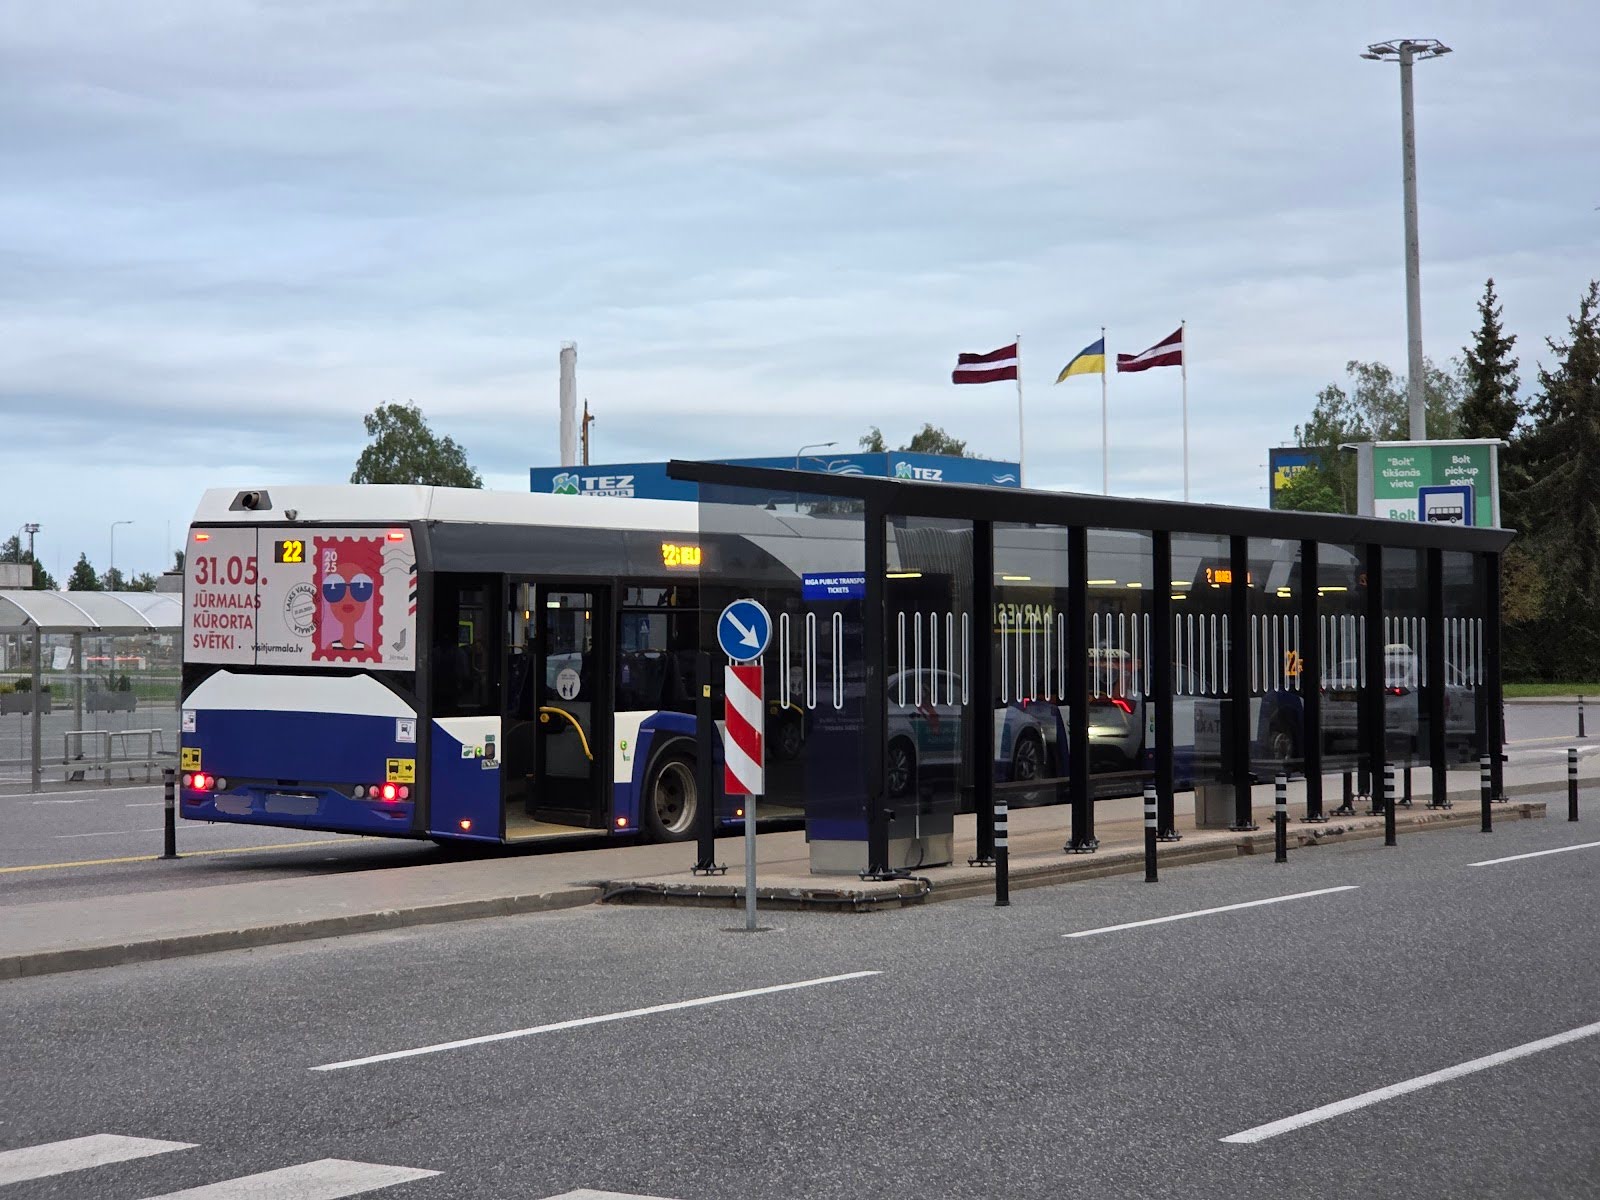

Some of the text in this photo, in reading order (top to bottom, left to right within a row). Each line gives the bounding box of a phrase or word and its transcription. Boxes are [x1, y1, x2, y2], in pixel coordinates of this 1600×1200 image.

[1452, 455, 1471, 464] Bolt
[912, 467, 943, 482] TEZ
[1382, 468, 1421, 478] tikšanās
[1444, 466, 1479, 477] pick-up
[581, 475, 635, 490] TEZ
[1389, 479, 1415, 488] vieta
[586, 489, 630, 498] TOUR
[1389, 509, 1416, 520] Bolt
[283, 540, 302, 562] 22
[324, 551, 338, 562] 20
[195, 555, 268, 585] 31.05.
[324, 562, 337, 573] 25
[839, 577, 866, 585] TRANSPO
[827, 586, 849, 594] TICKETS
[193, 589, 262, 609] JŪRMALAS
[193, 610, 254, 630] KŪRORTA
[193, 630, 235, 650] SVĒTKI
[250, 642, 303, 654] visitjurmala.lv
